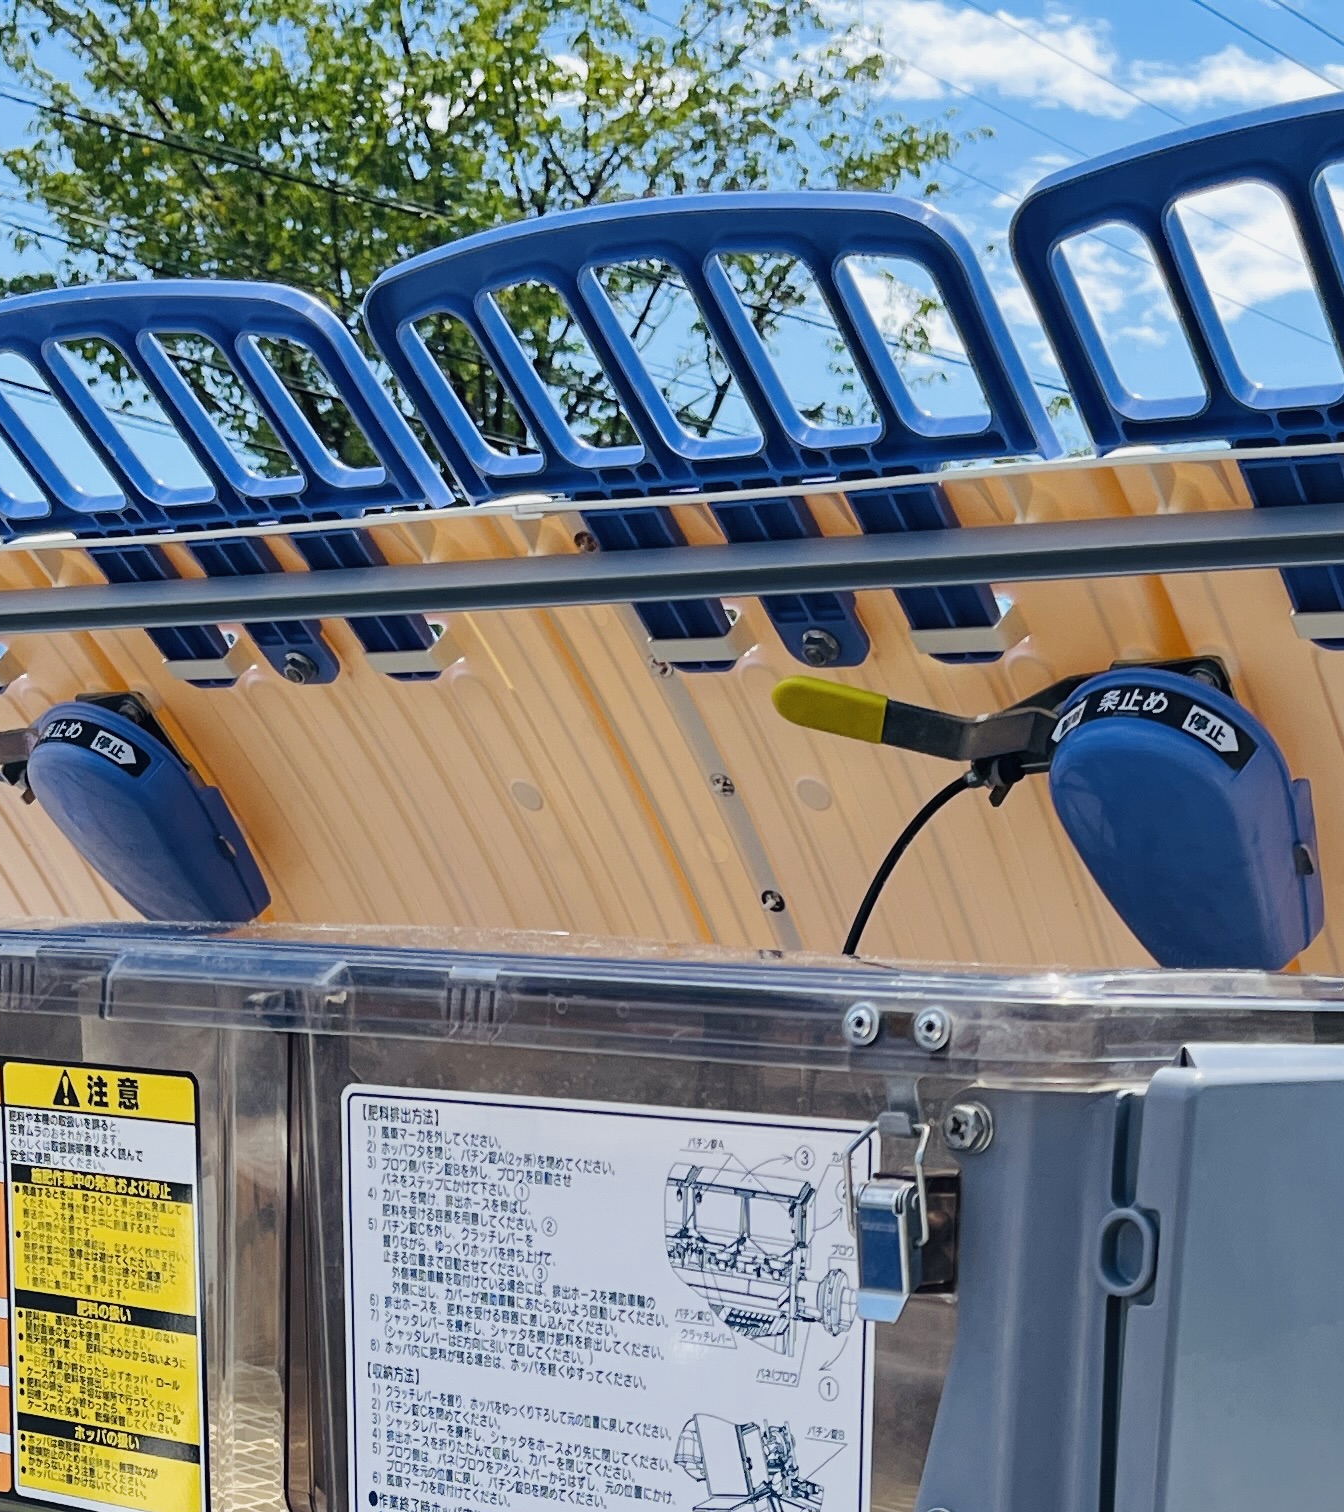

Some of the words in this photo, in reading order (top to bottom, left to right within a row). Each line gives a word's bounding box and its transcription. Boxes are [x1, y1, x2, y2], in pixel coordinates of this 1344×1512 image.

[1097, 689, 1169, 714] 条止め
[1188, 711, 1226, 747] 停止
[95, 735, 126, 759] 停止
[86, 1074, 139, 1110] 注意
[362, 1104, 440, 1127] 【肥料排出方法】
[9, 1123, 122, 1145] 生育ムラのおそれがあります。
[10, 1149, 105, 1171] 安全に使用してください。
[11, 1137, 143, 1162] くわしくは取扱説明書をよく読んで
[76, 1299, 131, 1323] 肥料の扱い
[680, 1328, 731, 1345] クラッチレバー
[367, 1362, 420, 1385] 【収納方法】
[74, 1423, 139, 1451] ホッパの扱い
